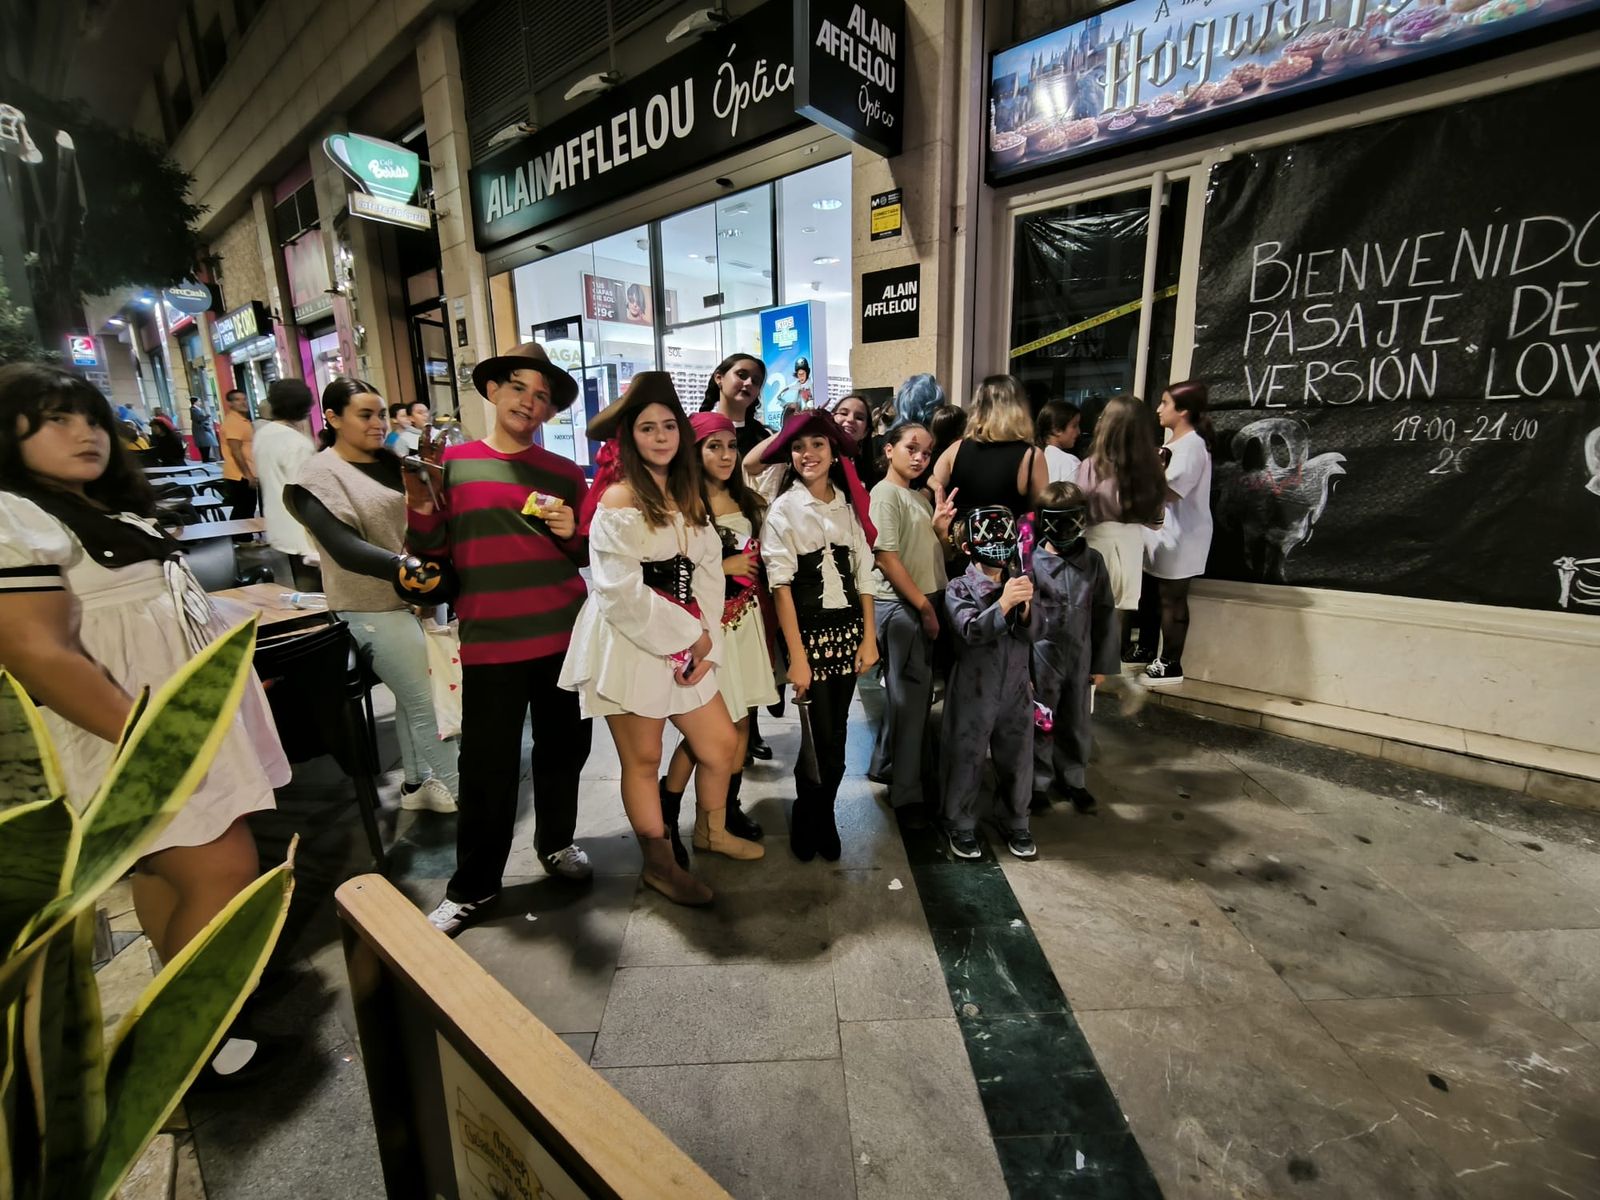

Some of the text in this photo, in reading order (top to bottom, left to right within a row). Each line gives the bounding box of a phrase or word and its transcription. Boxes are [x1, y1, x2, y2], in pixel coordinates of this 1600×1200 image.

[815, 19, 896, 94] AFFLELOU
[847, 3, 896, 61] ALAIN
[486, 150, 556, 223] ALAIN
[550, 77, 695, 195] AFFLELOU
[864, 297, 917, 318] AFFLELOU
[882, 280, 918, 300] ALAIN
[1244, 293, 1463, 357] PASAJE
[1244, 348, 1438, 408] VERSIÓN
[1392, 415, 1455, 443] 19:00
